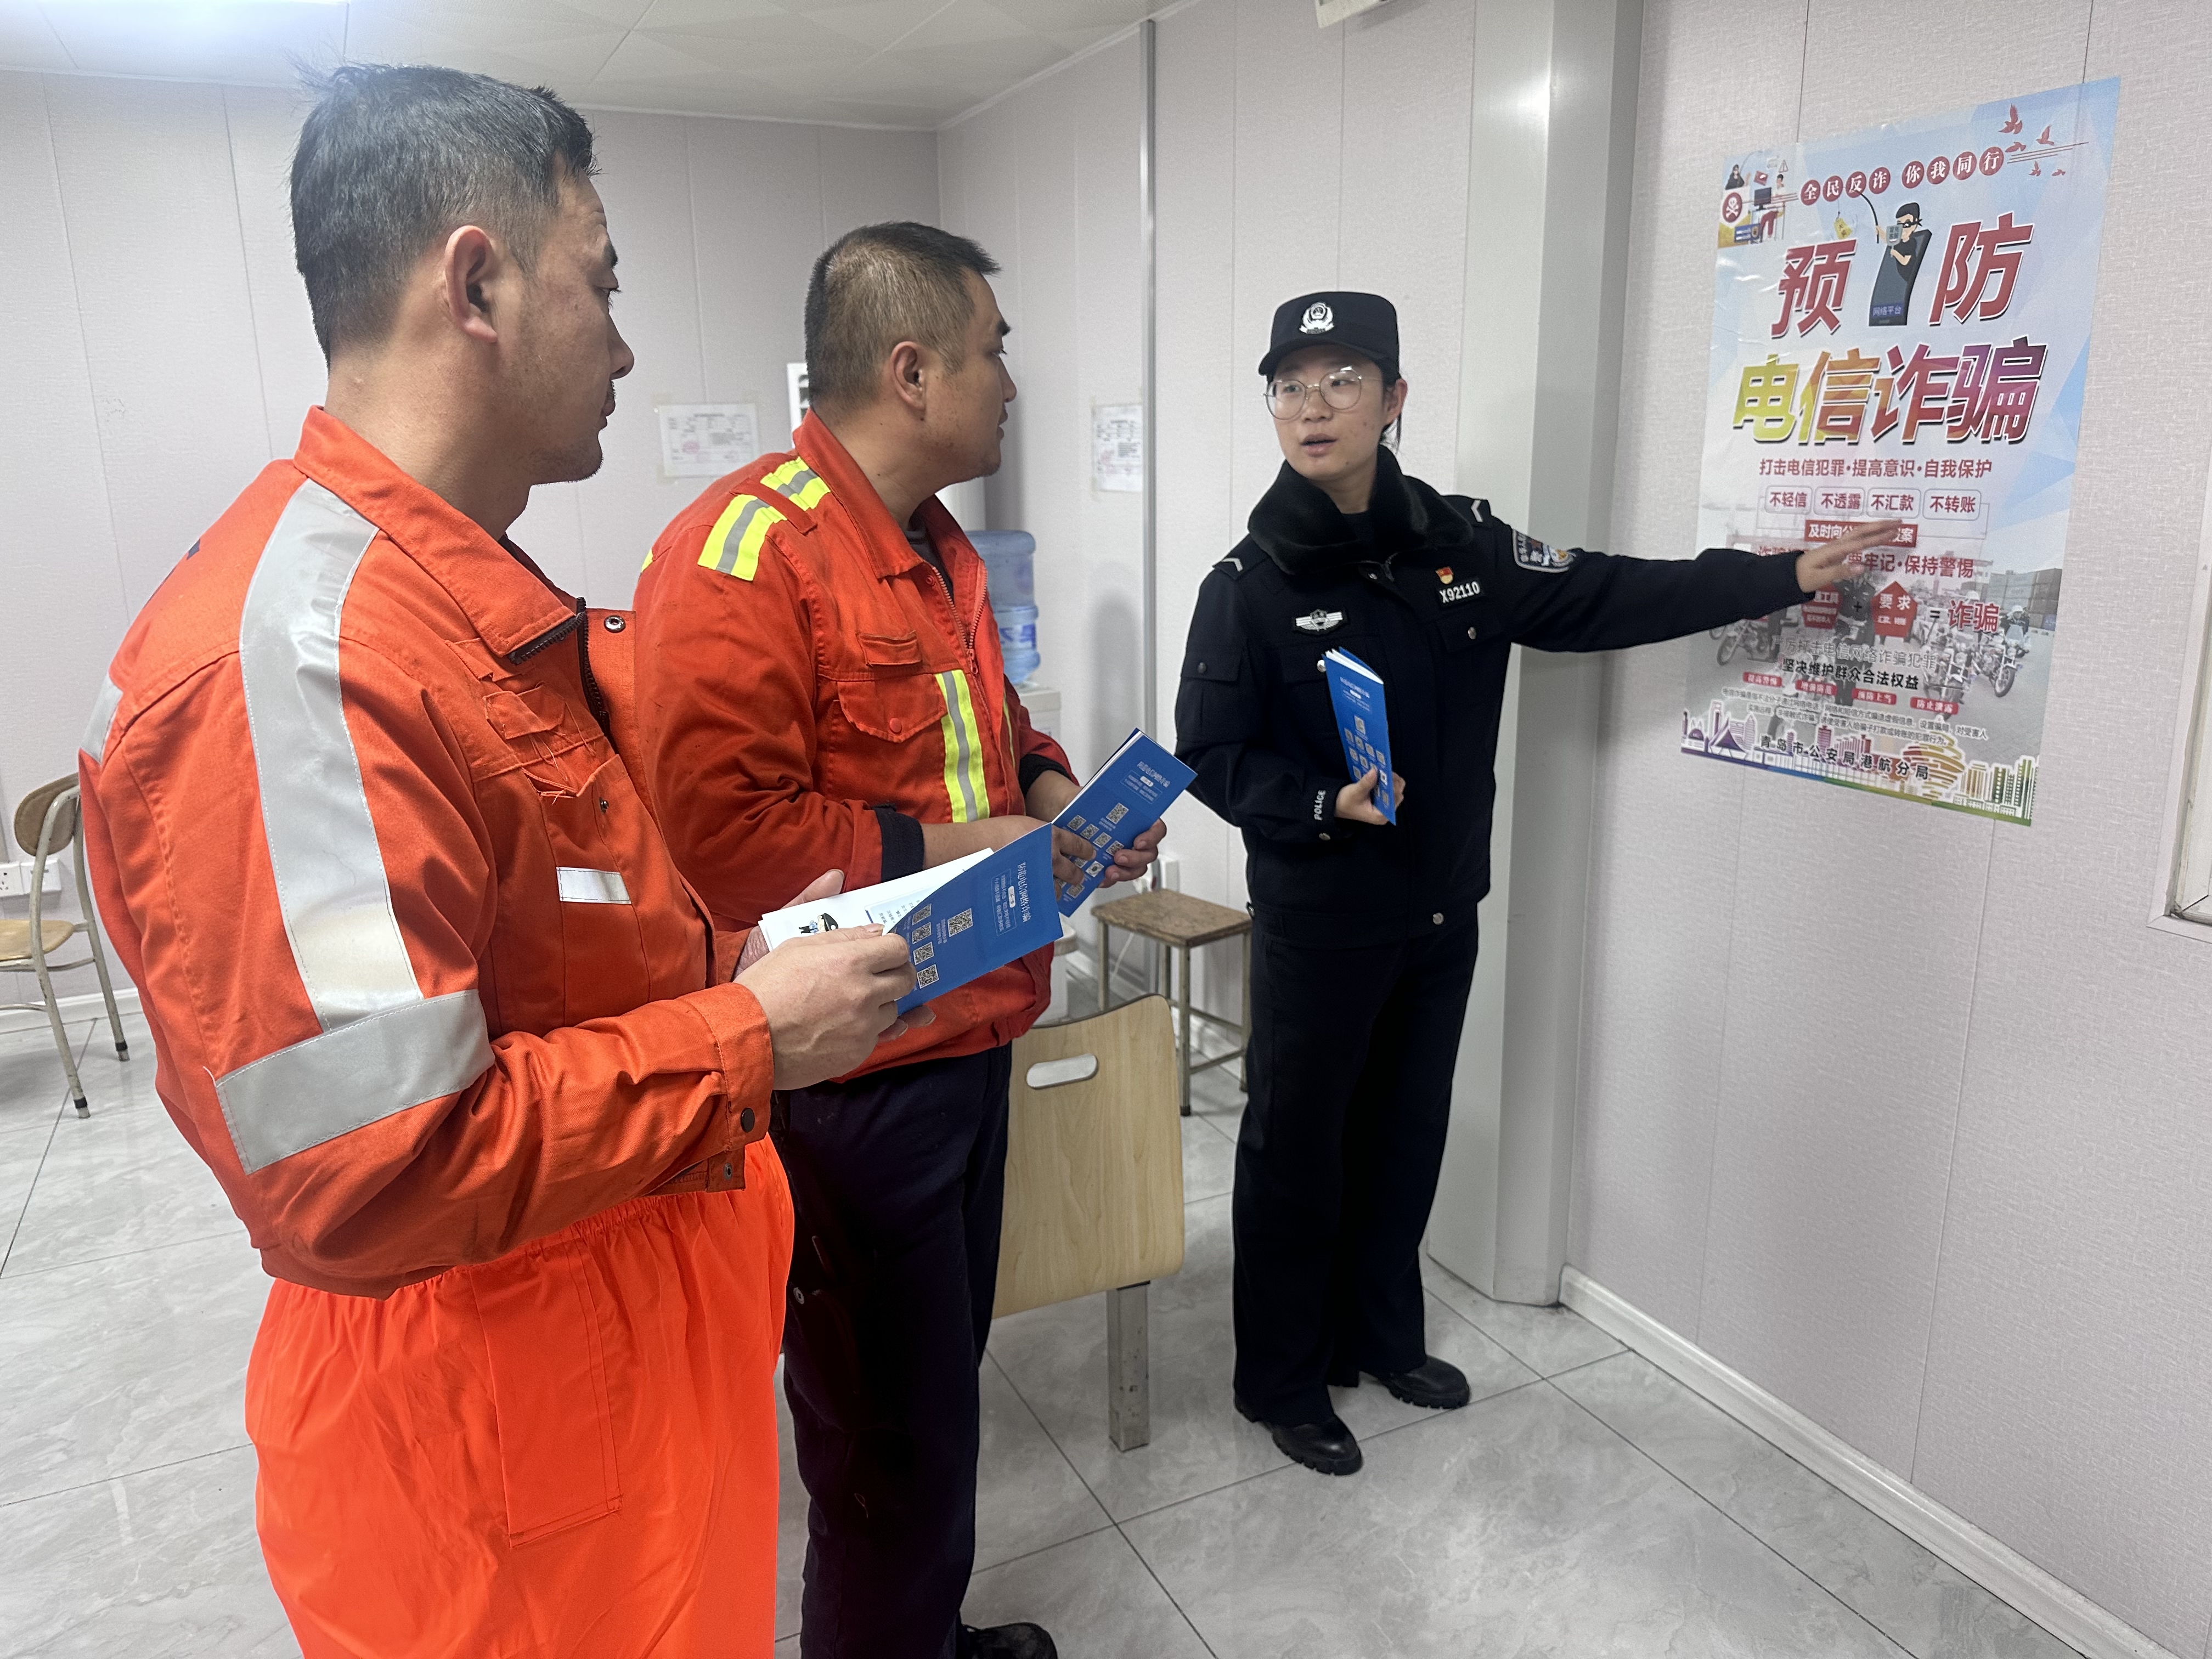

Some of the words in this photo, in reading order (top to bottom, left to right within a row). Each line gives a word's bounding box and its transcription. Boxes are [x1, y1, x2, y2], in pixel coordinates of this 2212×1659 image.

[1803, 171, 1888, 201] 全民反诈
[1905, 151, 2000, 184] 你我同行
[1770, 239, 1857, 339] 预
[1928, 211, 2034, 324] 防
[1872, 305, 1902, 317] 网络平台
[1732, 336, 2048, 445] 电信诈骗
[1769, 491, 1808, 508] 不轻信
[1821, 492, 1861, 510] 不透露
[1871, 494, 1915, 511] 不汇款
[1929, 495, 1976, 514] 不转账
[1439, 581, 1481, 603] X92110
[1879, 593, 1911, 611] 要求
[1948, 600, 2000, 633] 诈骗
[1782, 658, 1919, 690] 坚决维护群众合法权益
[1760, 735, 1929, 780] 青岛市公安局港航分局
[1313, 789, 1327, 821] POLICE
